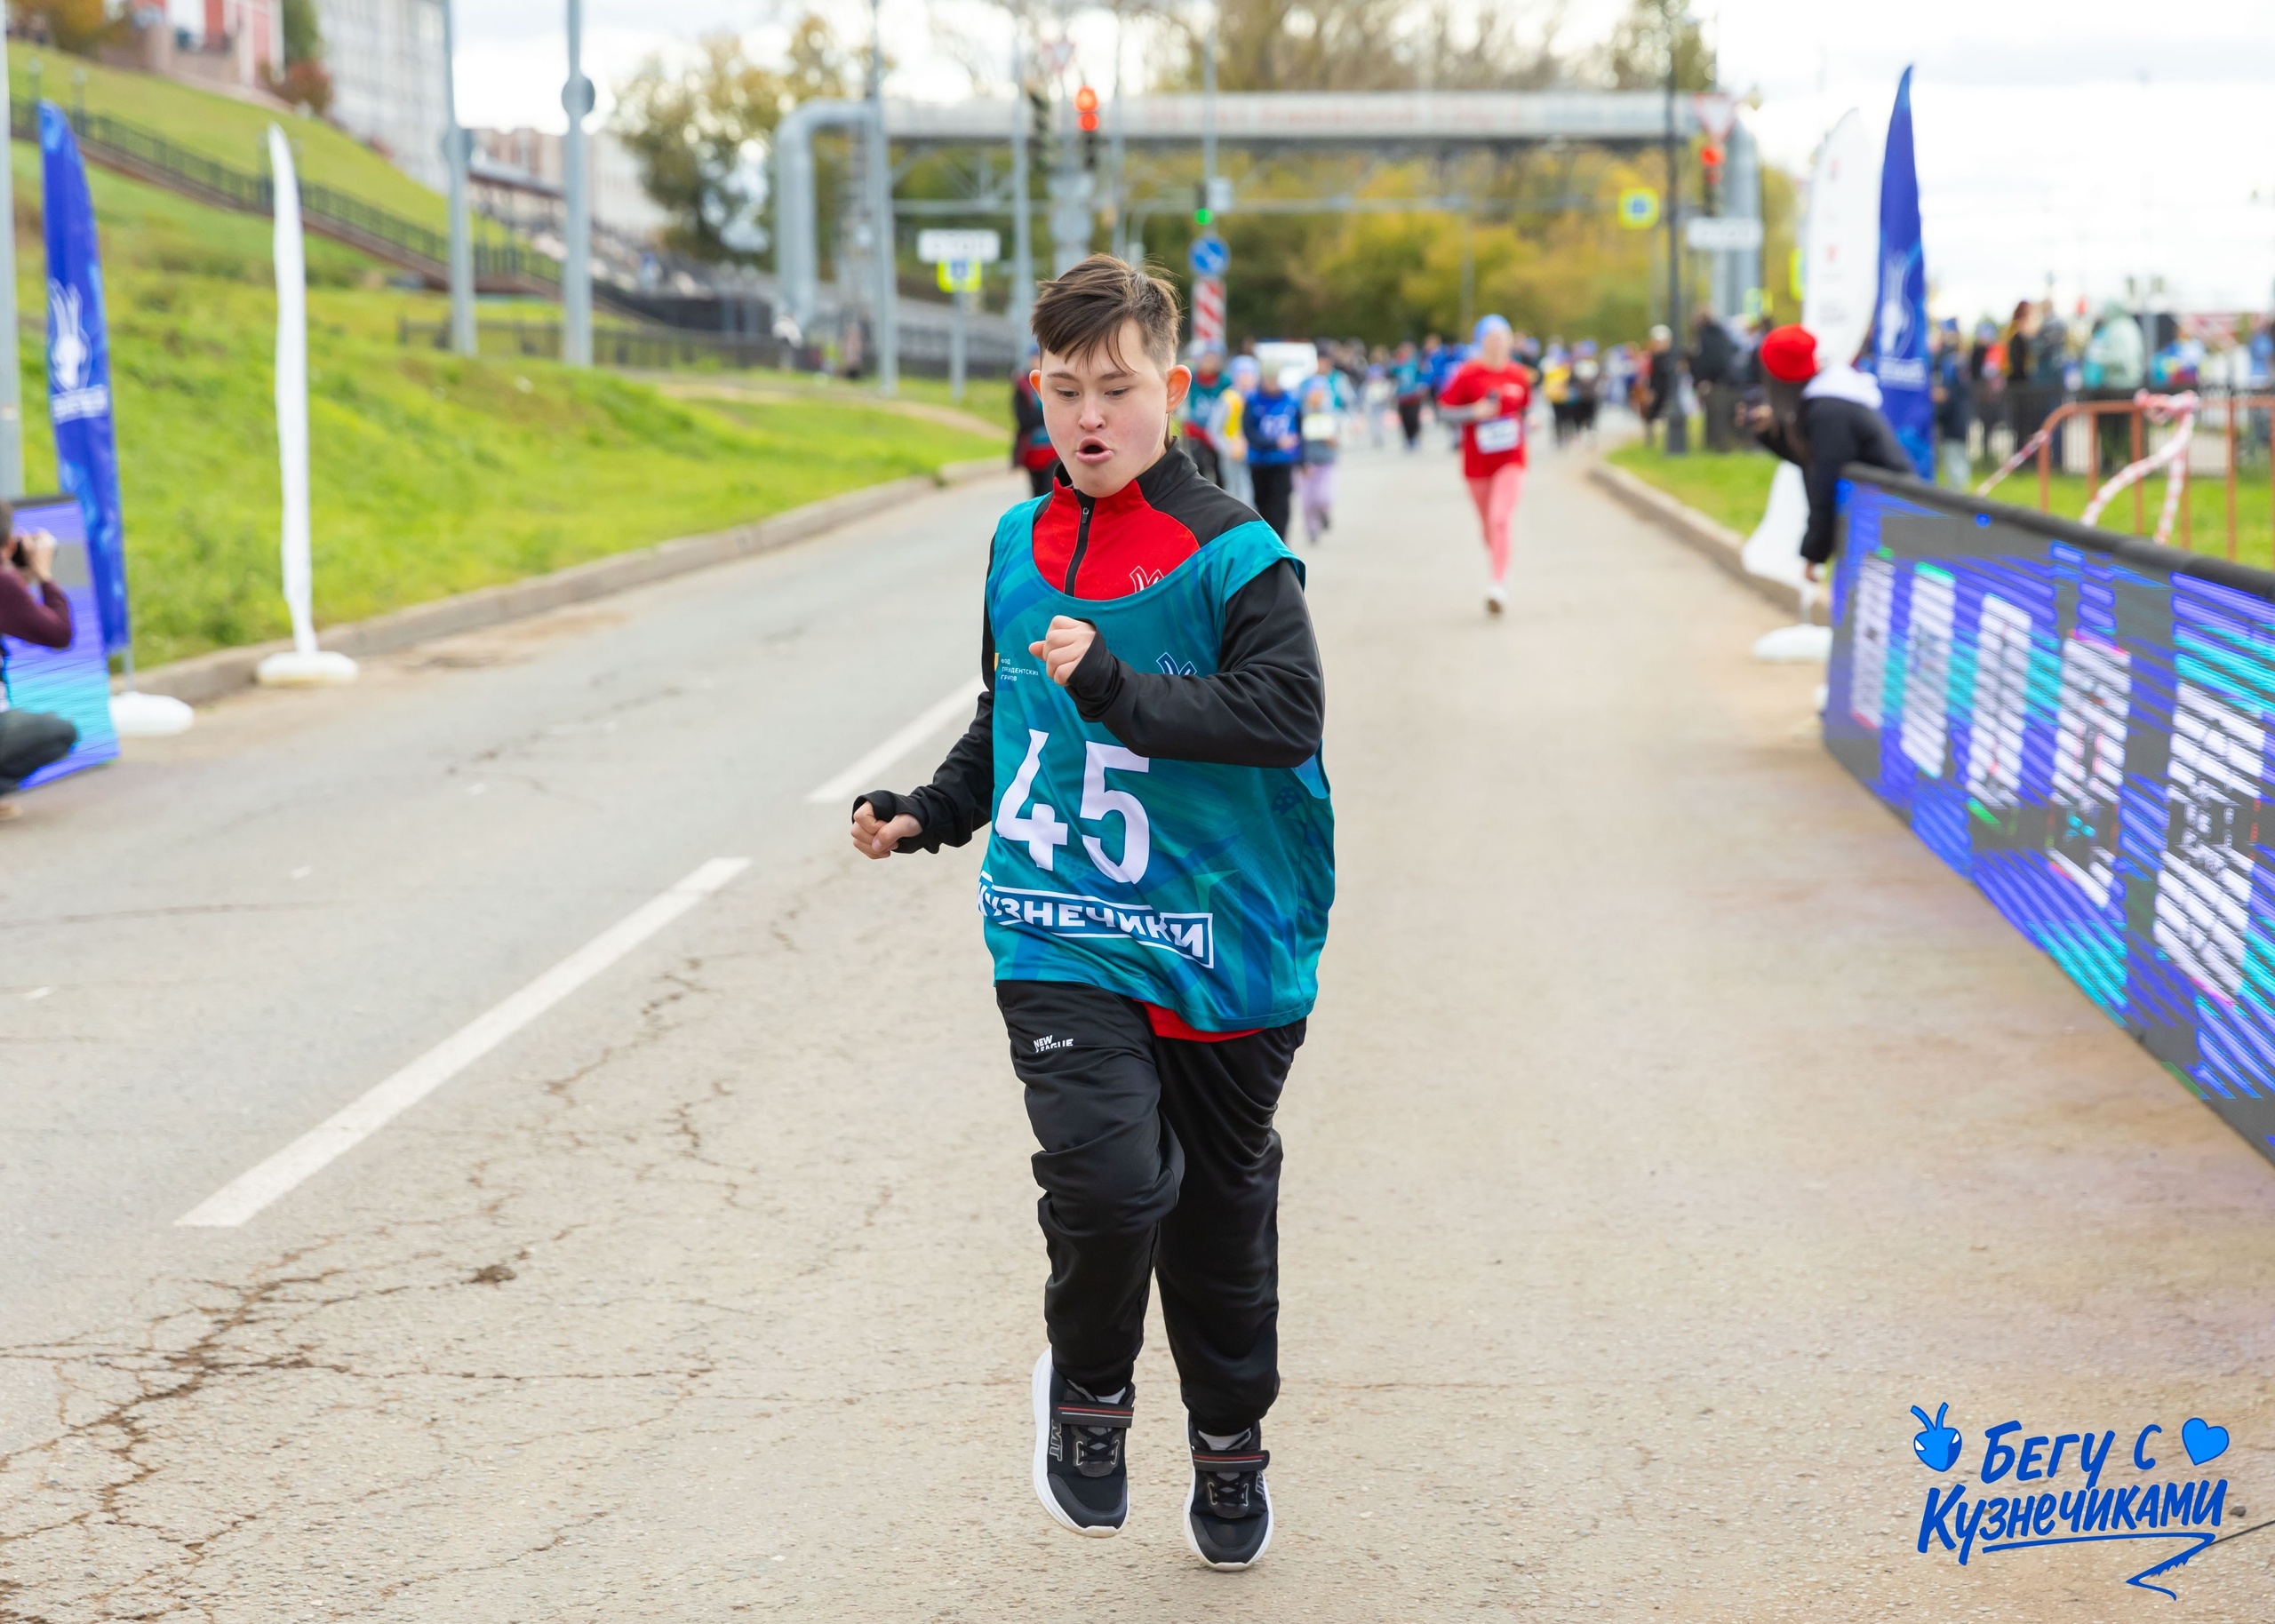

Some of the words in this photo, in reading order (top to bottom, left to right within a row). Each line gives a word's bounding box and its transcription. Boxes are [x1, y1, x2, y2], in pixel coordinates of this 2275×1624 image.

[995, 728, 1150, 884] 45
[978, 881, 1204, 958] КУЗНЕЧИКИ
[1034, 1035, 1053, 1048] NEW
